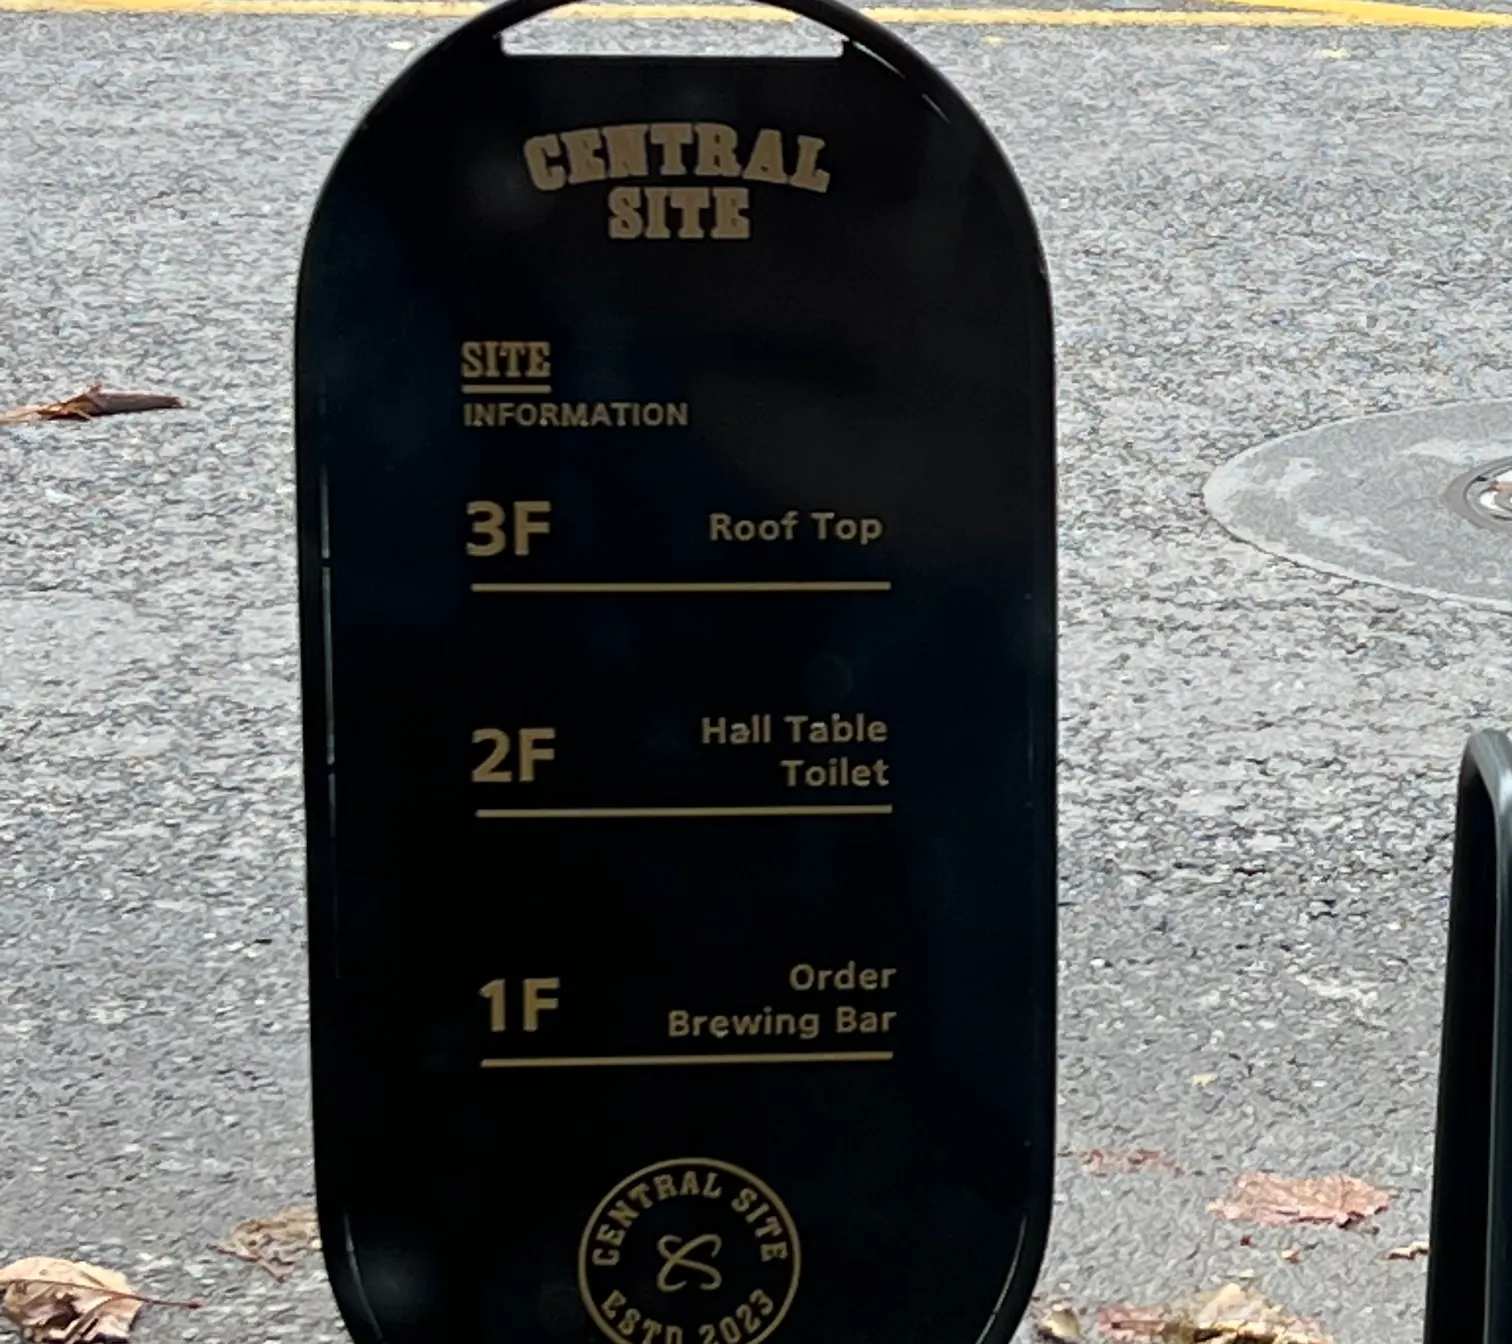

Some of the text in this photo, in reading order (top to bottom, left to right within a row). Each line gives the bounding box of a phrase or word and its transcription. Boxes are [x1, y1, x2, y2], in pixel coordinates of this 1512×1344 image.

[523, 122, 831, 193] CENTRAL
[608, 186, 751, 240] SITE
[461, 341, 551, 378] SITE
[463, 402, 689, 427] INFORMATION
[465, 500, 883, 557] 3F Roof Top
[701, 712, 888, 745] Hall Table
[471, 727, 557, 783] 2F
[780, 758, 890, 787] Toilet
[789, 961, 897, 991] Order
[479, 976, 560, 1032] 1F
[667, 1006, 897, 1039] Brewing Bar
[592, 1170, 789, 1266] CENTRAL SITE
